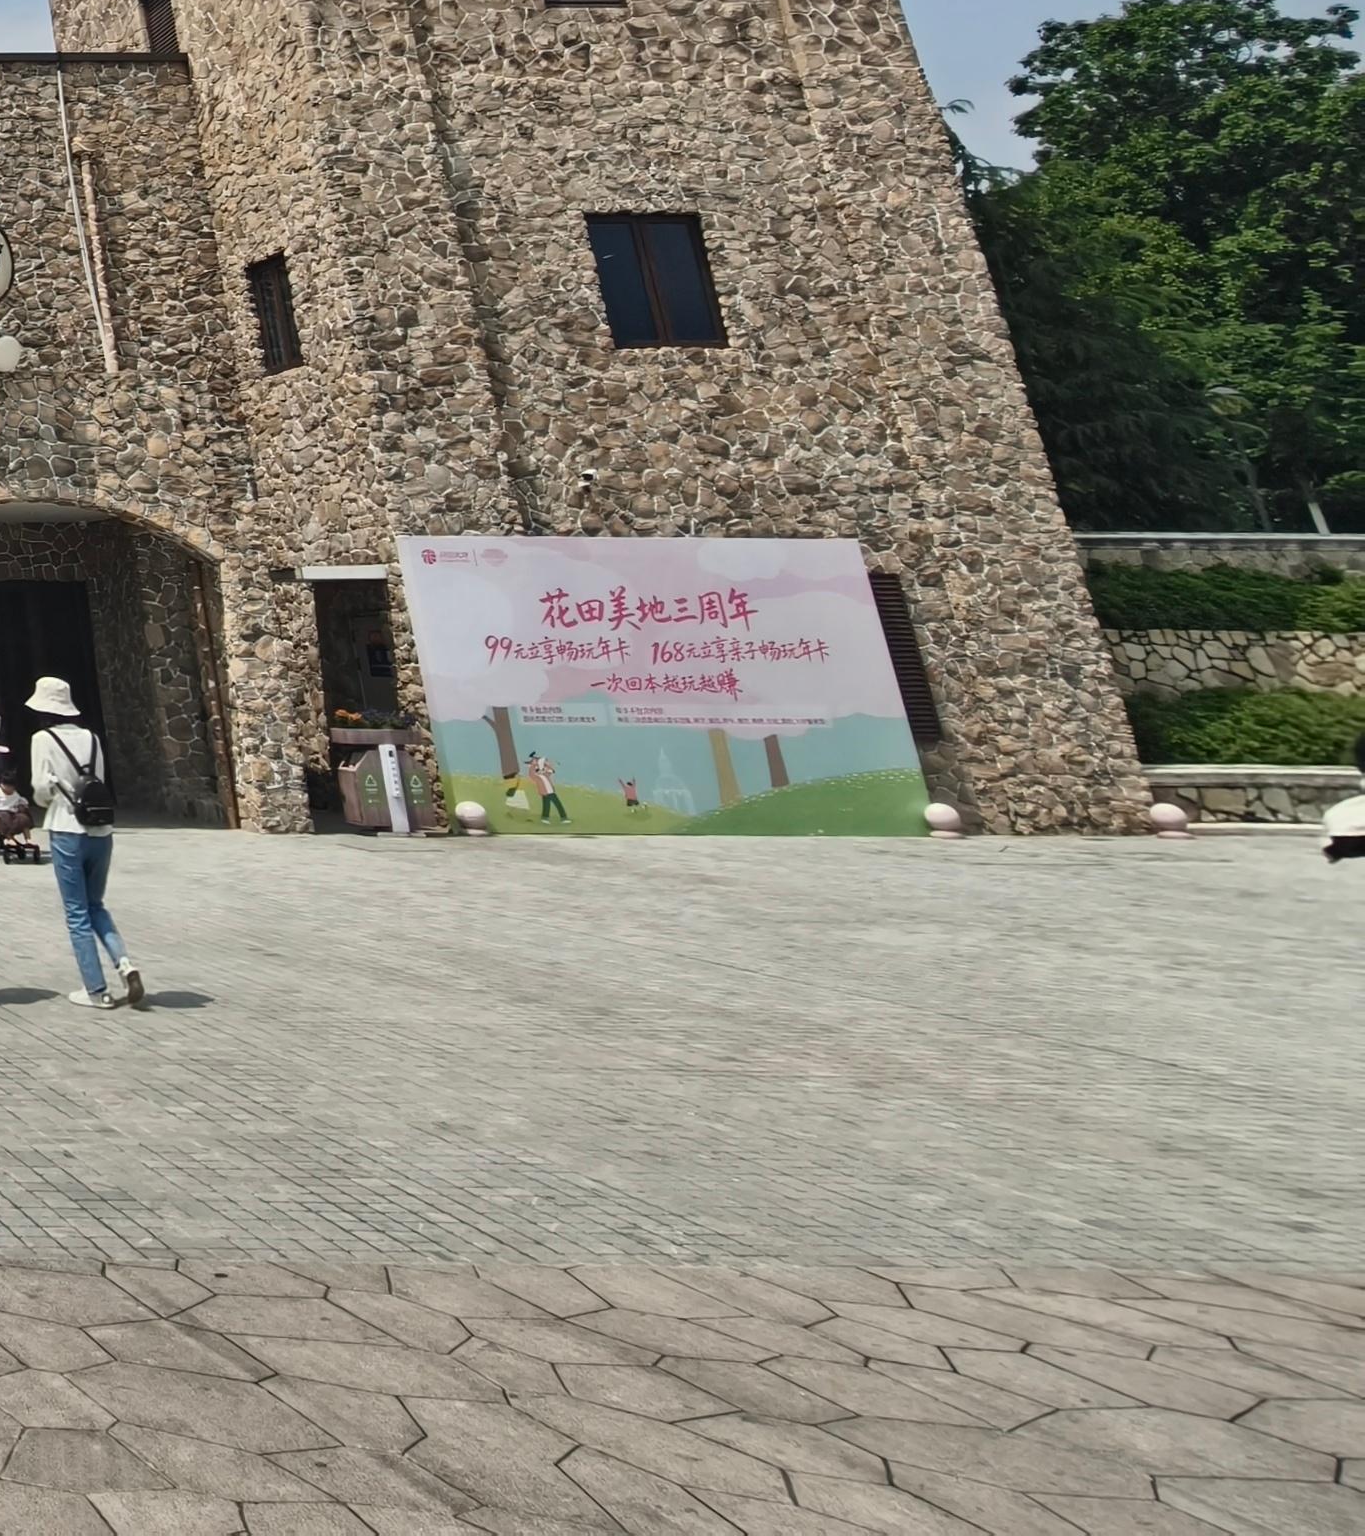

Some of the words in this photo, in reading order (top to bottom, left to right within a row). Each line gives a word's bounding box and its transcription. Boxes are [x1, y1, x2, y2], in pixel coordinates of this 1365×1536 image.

[539, 585, 759, 632] 花田美地三周年
